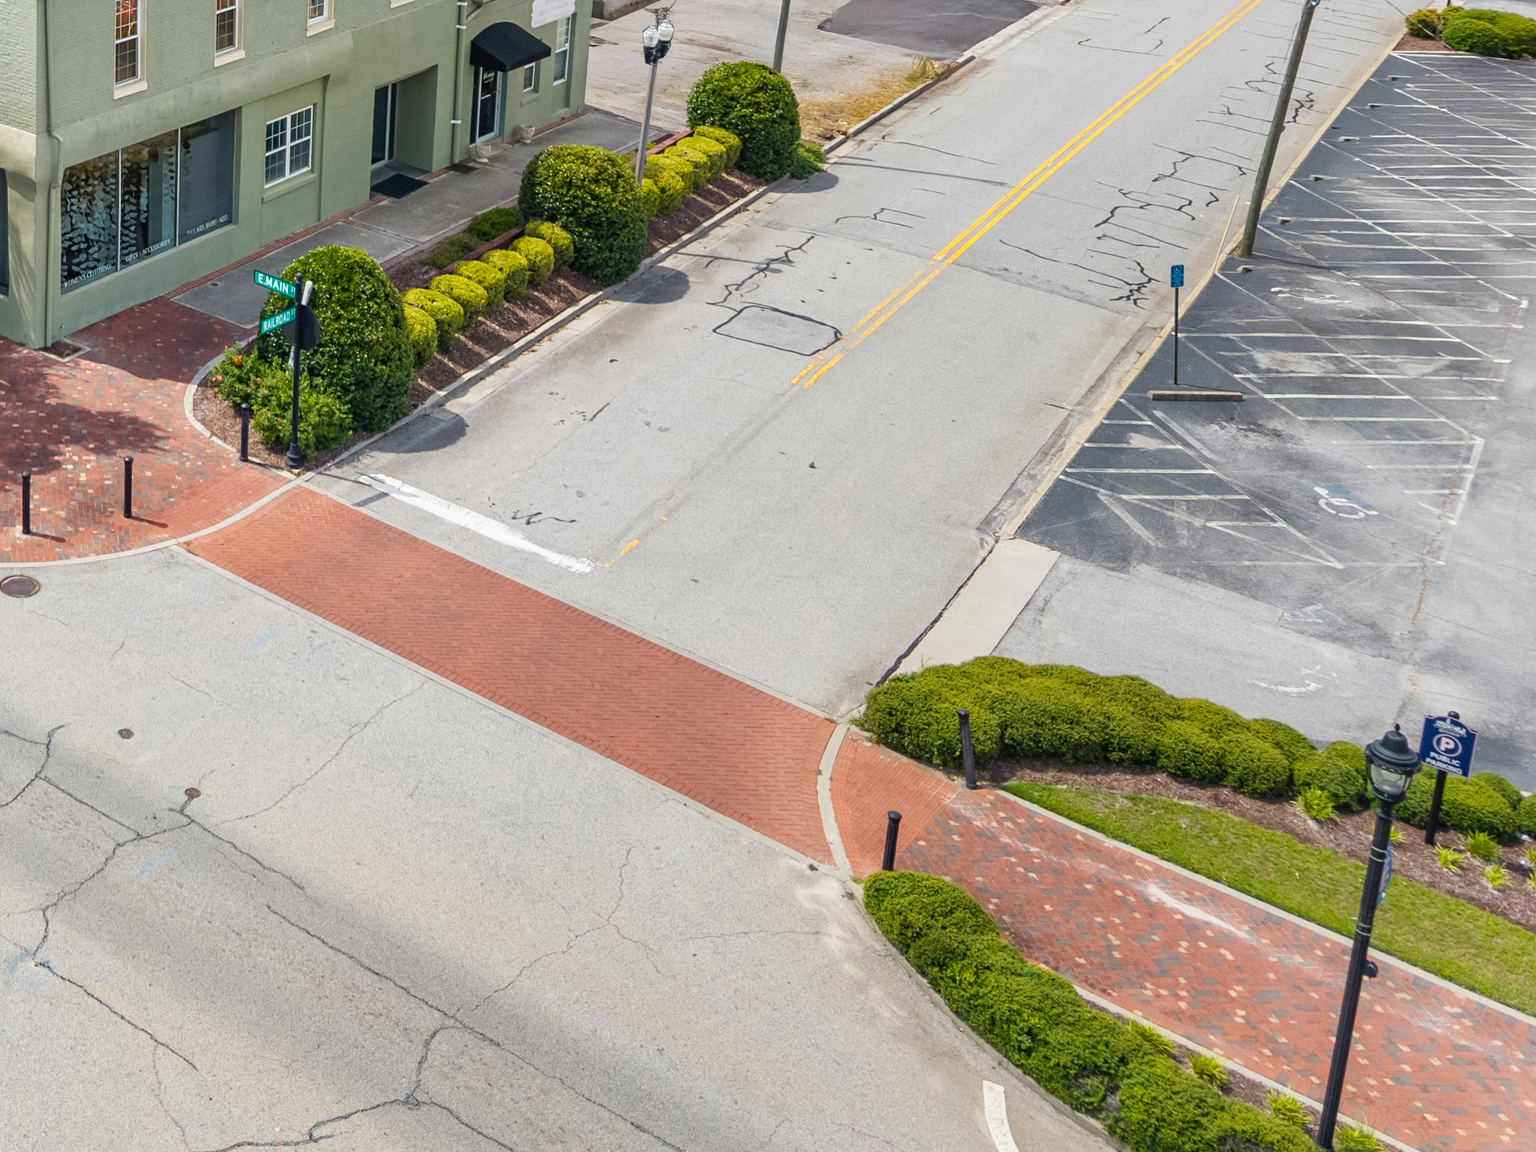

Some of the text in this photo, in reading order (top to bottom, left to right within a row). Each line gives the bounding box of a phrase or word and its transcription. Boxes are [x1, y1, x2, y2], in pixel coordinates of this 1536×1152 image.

[263, 311, 291, 331] RAILROAD
[1425, 757, 1463, 775] PARKING
[1430, 751, 1461, 767] PUBLIC
